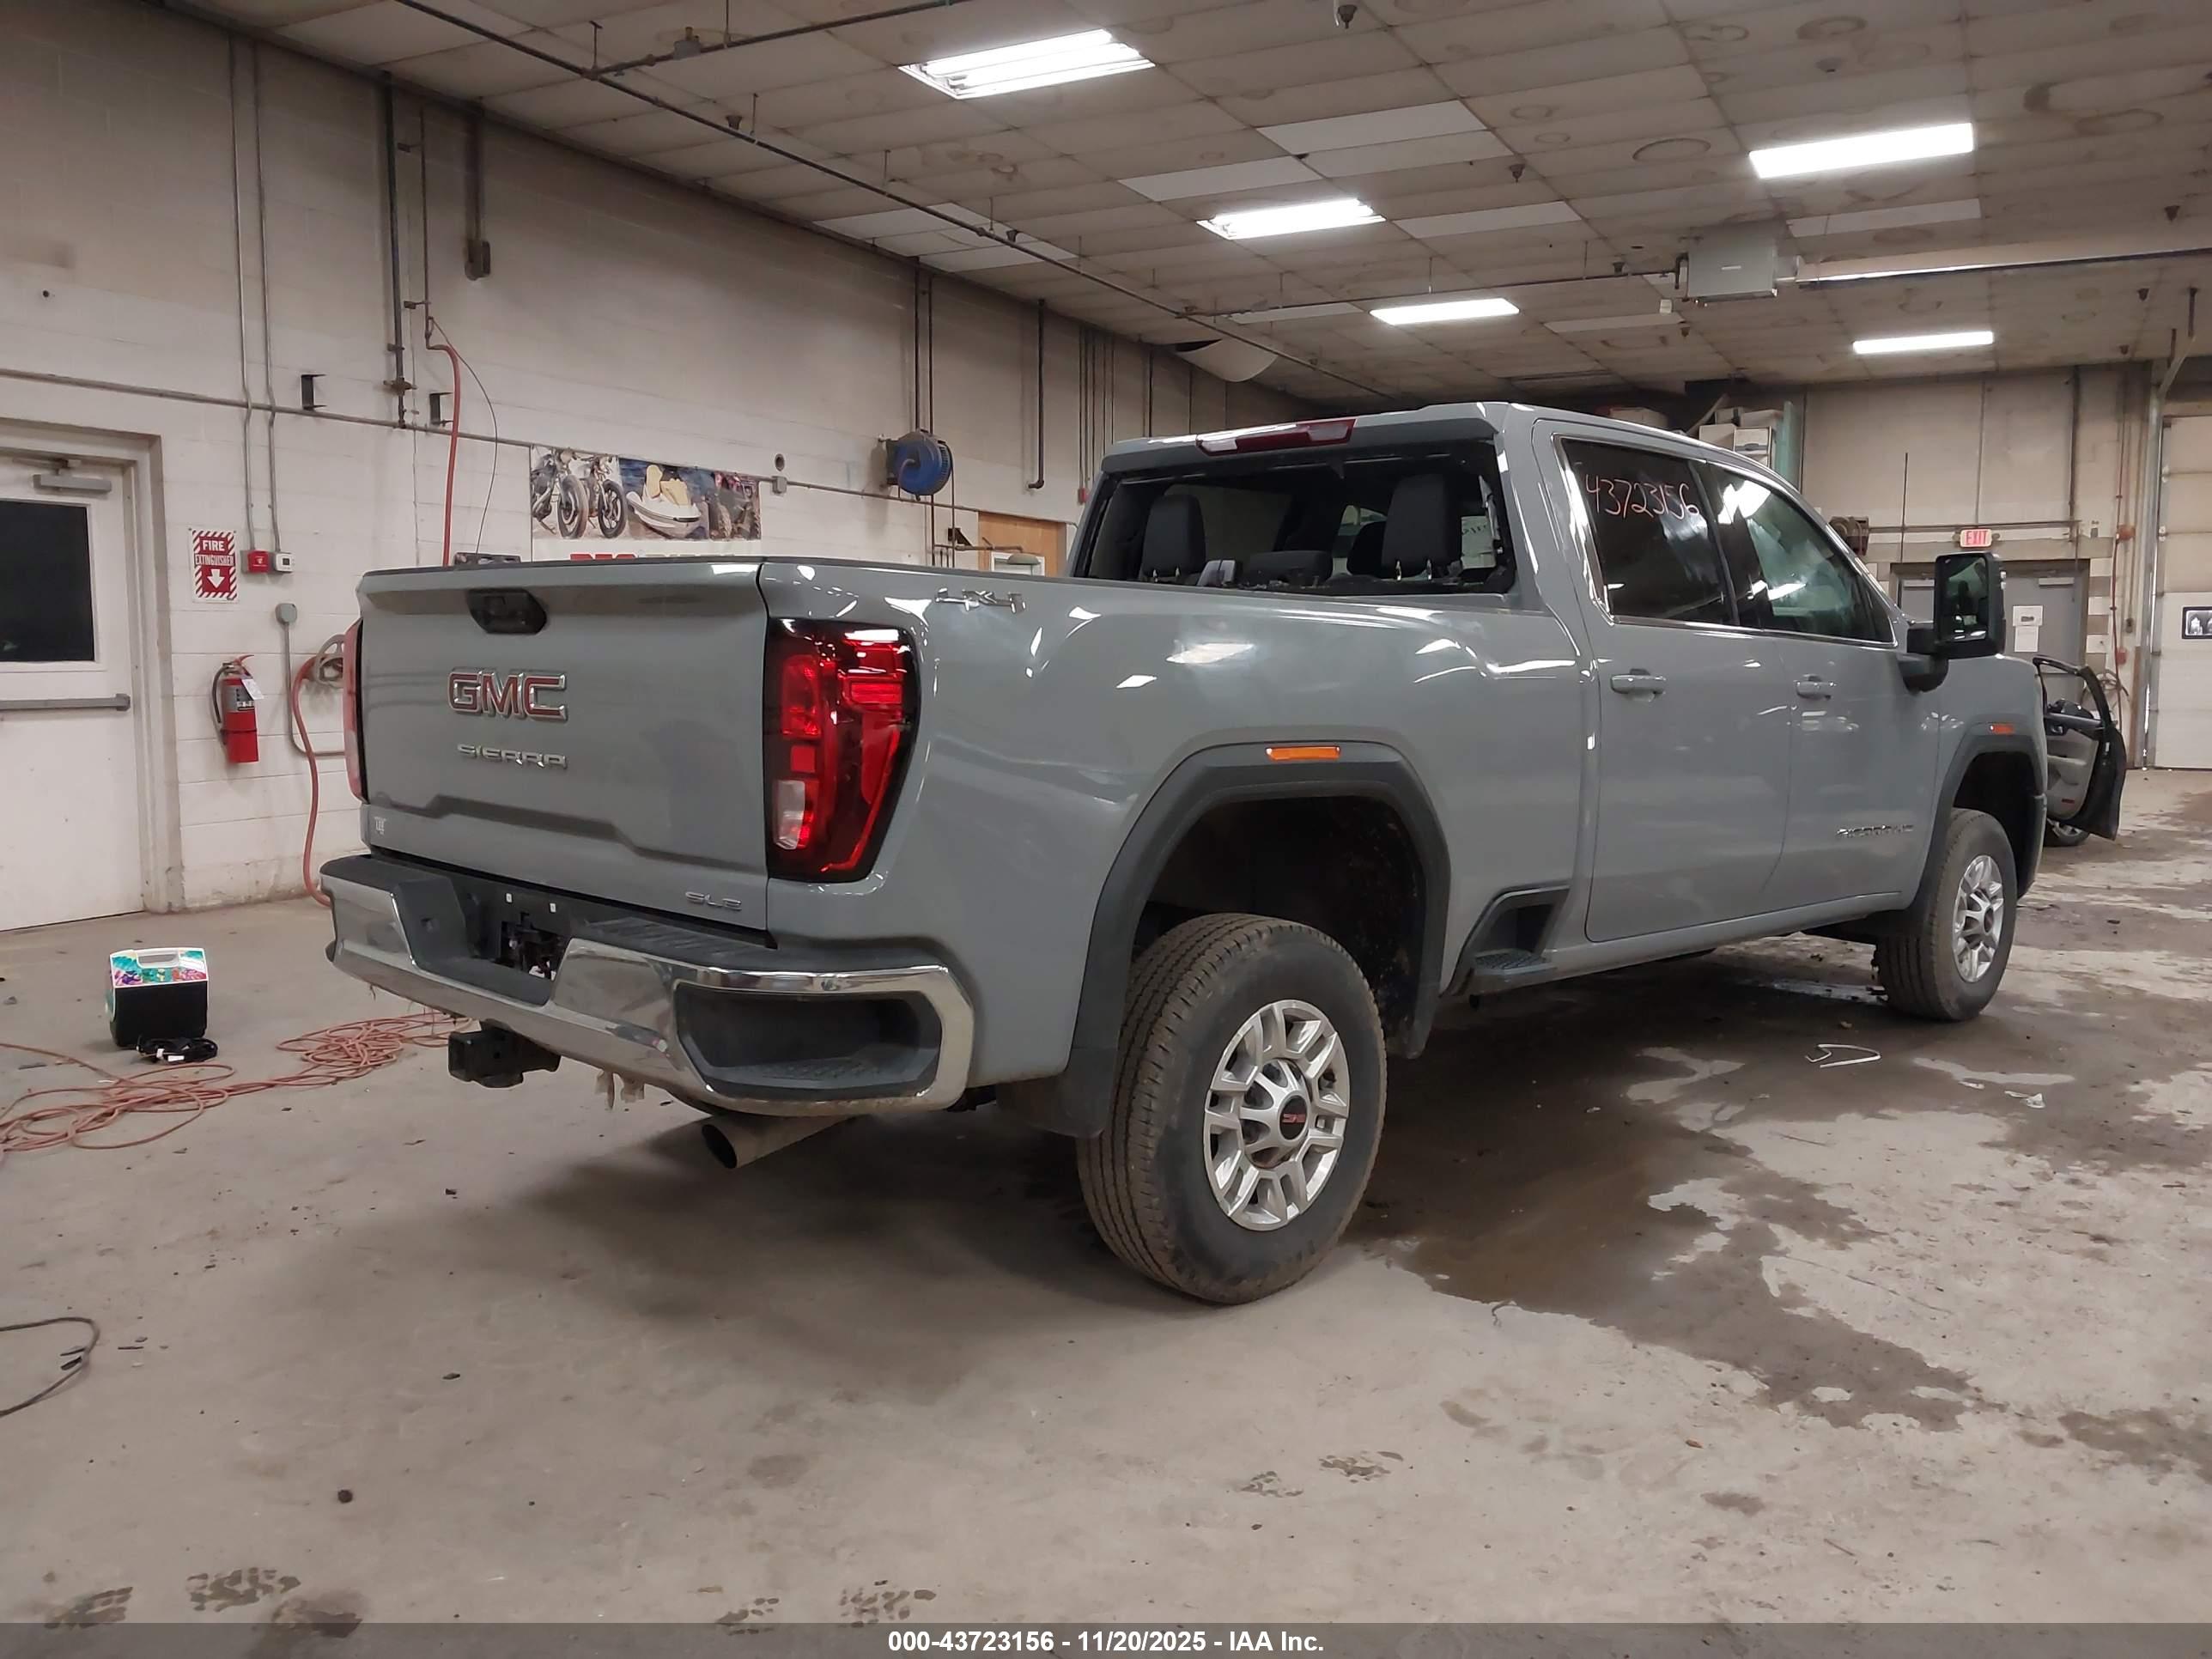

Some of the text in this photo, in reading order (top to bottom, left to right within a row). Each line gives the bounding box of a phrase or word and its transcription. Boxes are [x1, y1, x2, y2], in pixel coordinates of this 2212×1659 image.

[1586, 474, 1699, 520] 43723156
[202, 540, 225, 551] FIRE
[1966, 530, 1988, 545] EXIT
[195, 555, 234, 567] EXTINGUISHER
[448, 671, 568, 722] GMC
[457, 744, 568, 769] SIERRA
